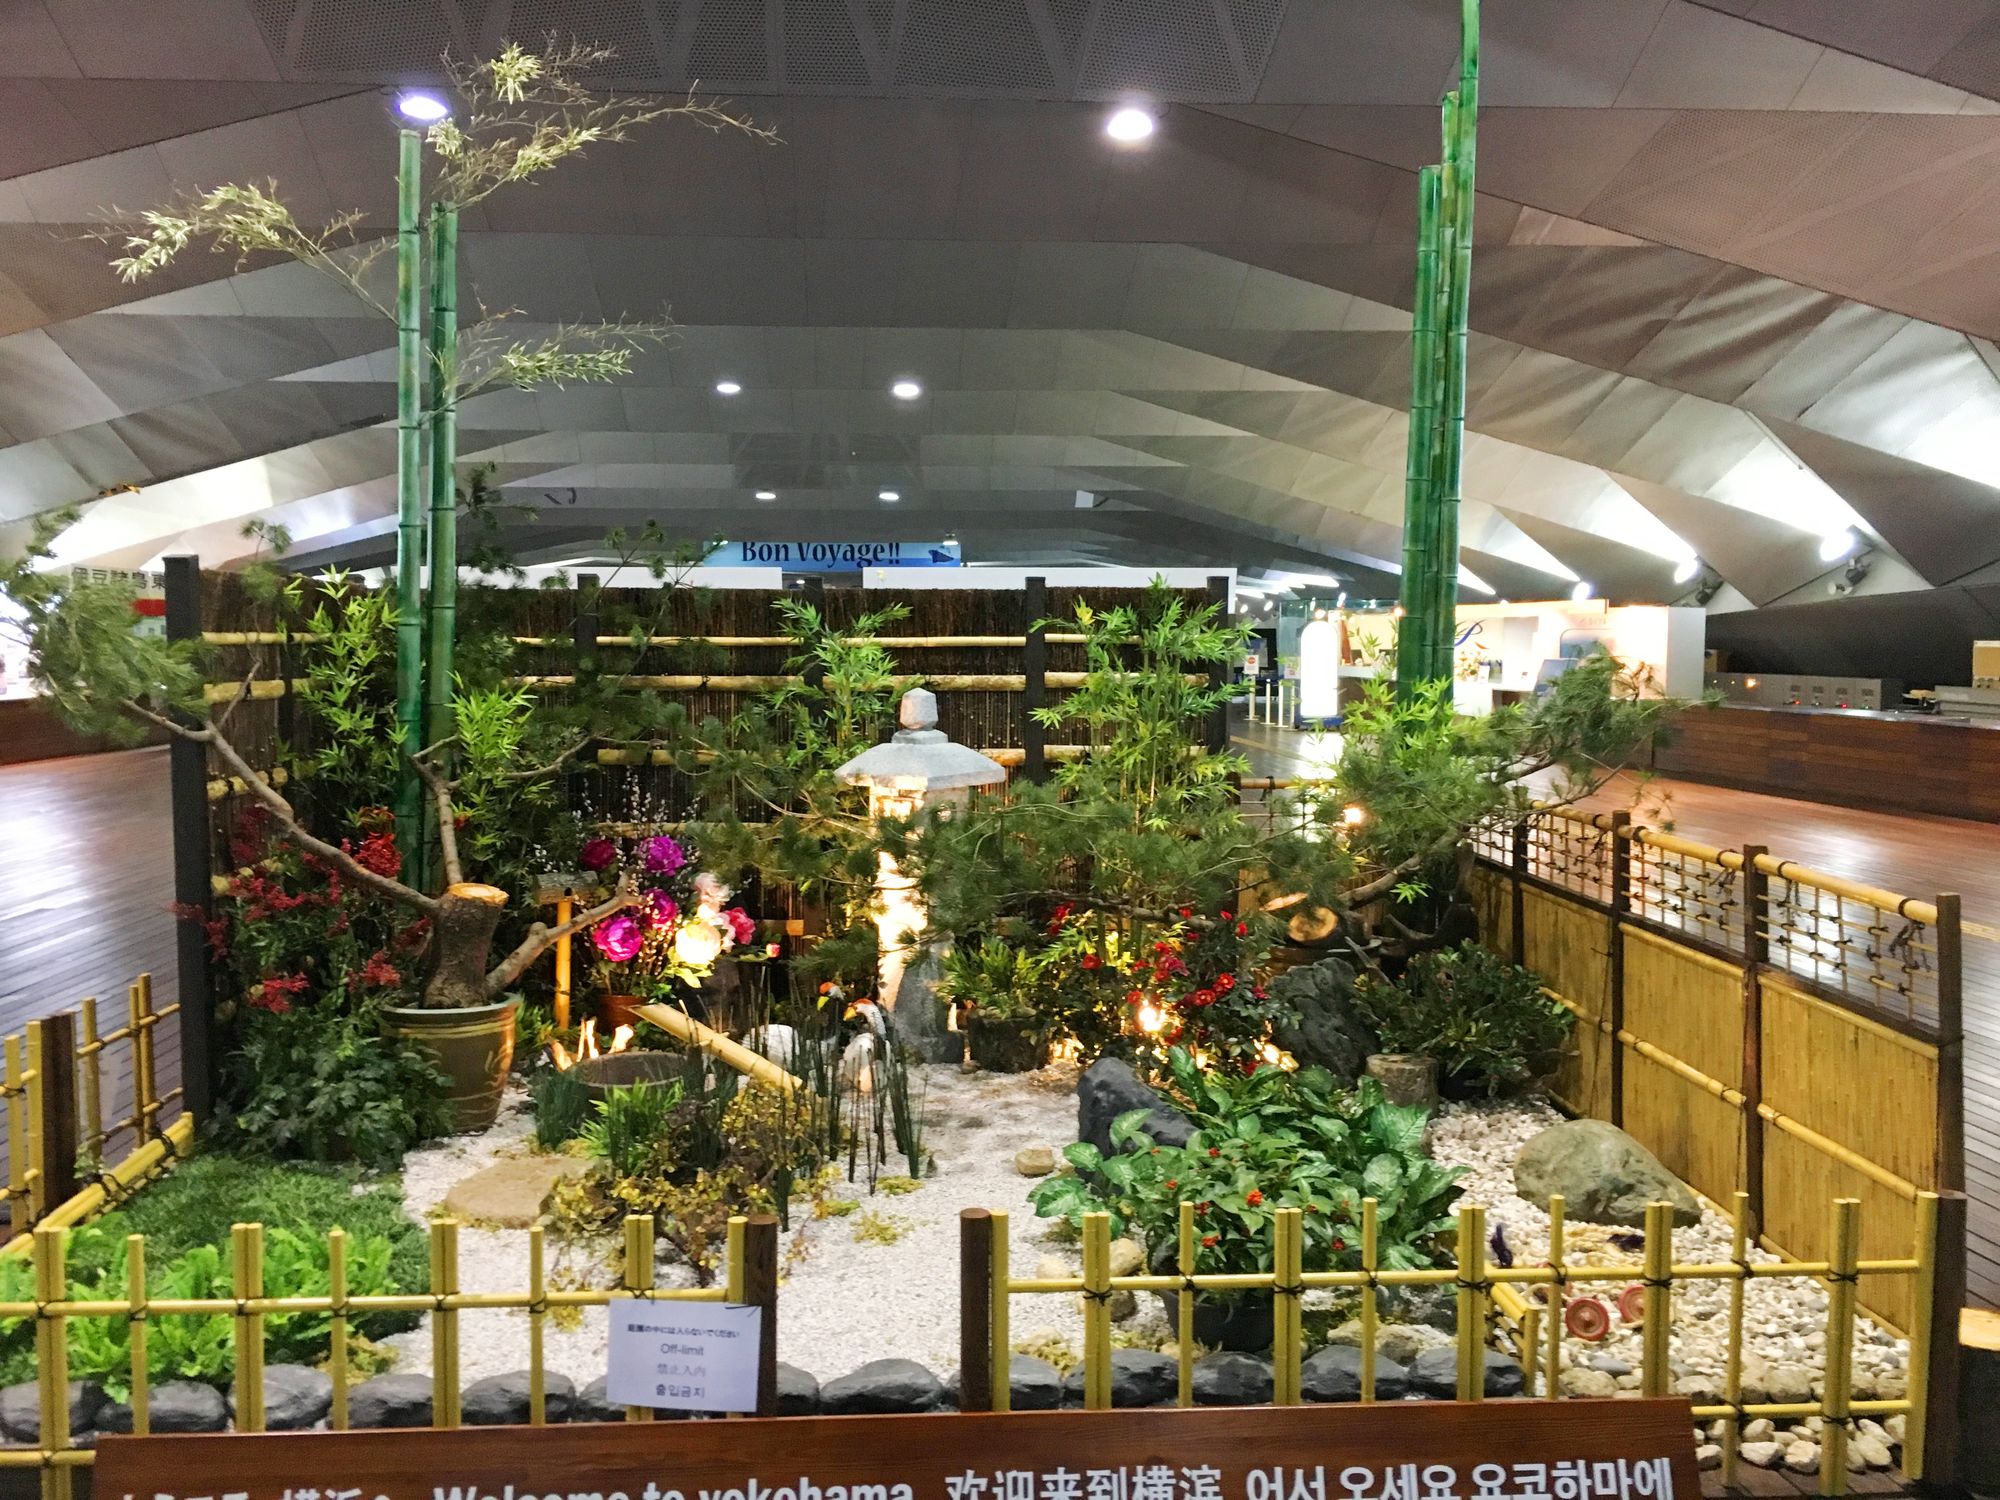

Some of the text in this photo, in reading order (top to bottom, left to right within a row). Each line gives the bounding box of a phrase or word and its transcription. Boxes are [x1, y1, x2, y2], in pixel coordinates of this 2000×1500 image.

[742, 541, 900, 568] Bon Voyage!!
[660, 1343, 704, 1356] Off-limit
[656, 1384, 705, 1398] 출입금지
[1246, 1457, 1673, 1500] 어서 오세요 요코하마에
